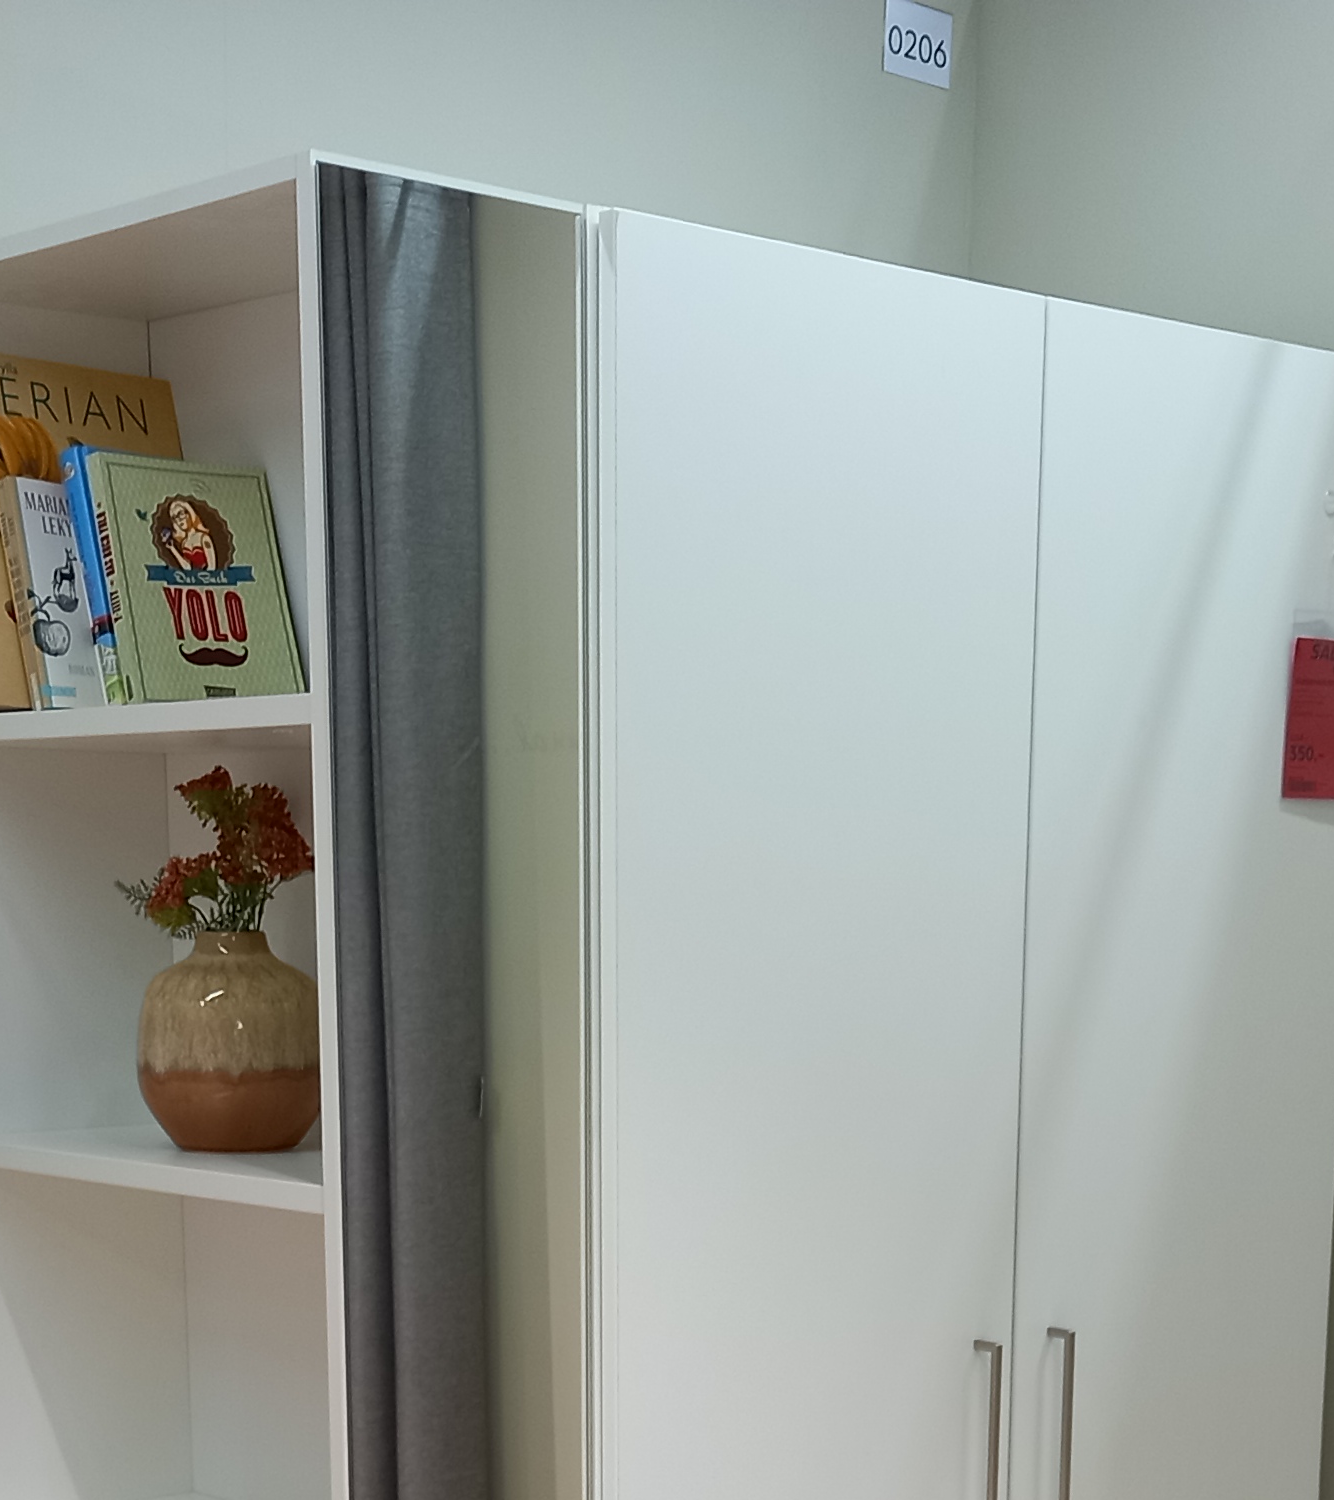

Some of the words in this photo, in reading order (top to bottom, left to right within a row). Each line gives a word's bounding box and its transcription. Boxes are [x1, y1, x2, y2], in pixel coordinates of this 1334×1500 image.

[888, 25, 947, 69] 0206
[41, 515, 73, 538] LEKY
[174, 570, 196, 584] Das
[162, 586, 248, 643] YOLO
